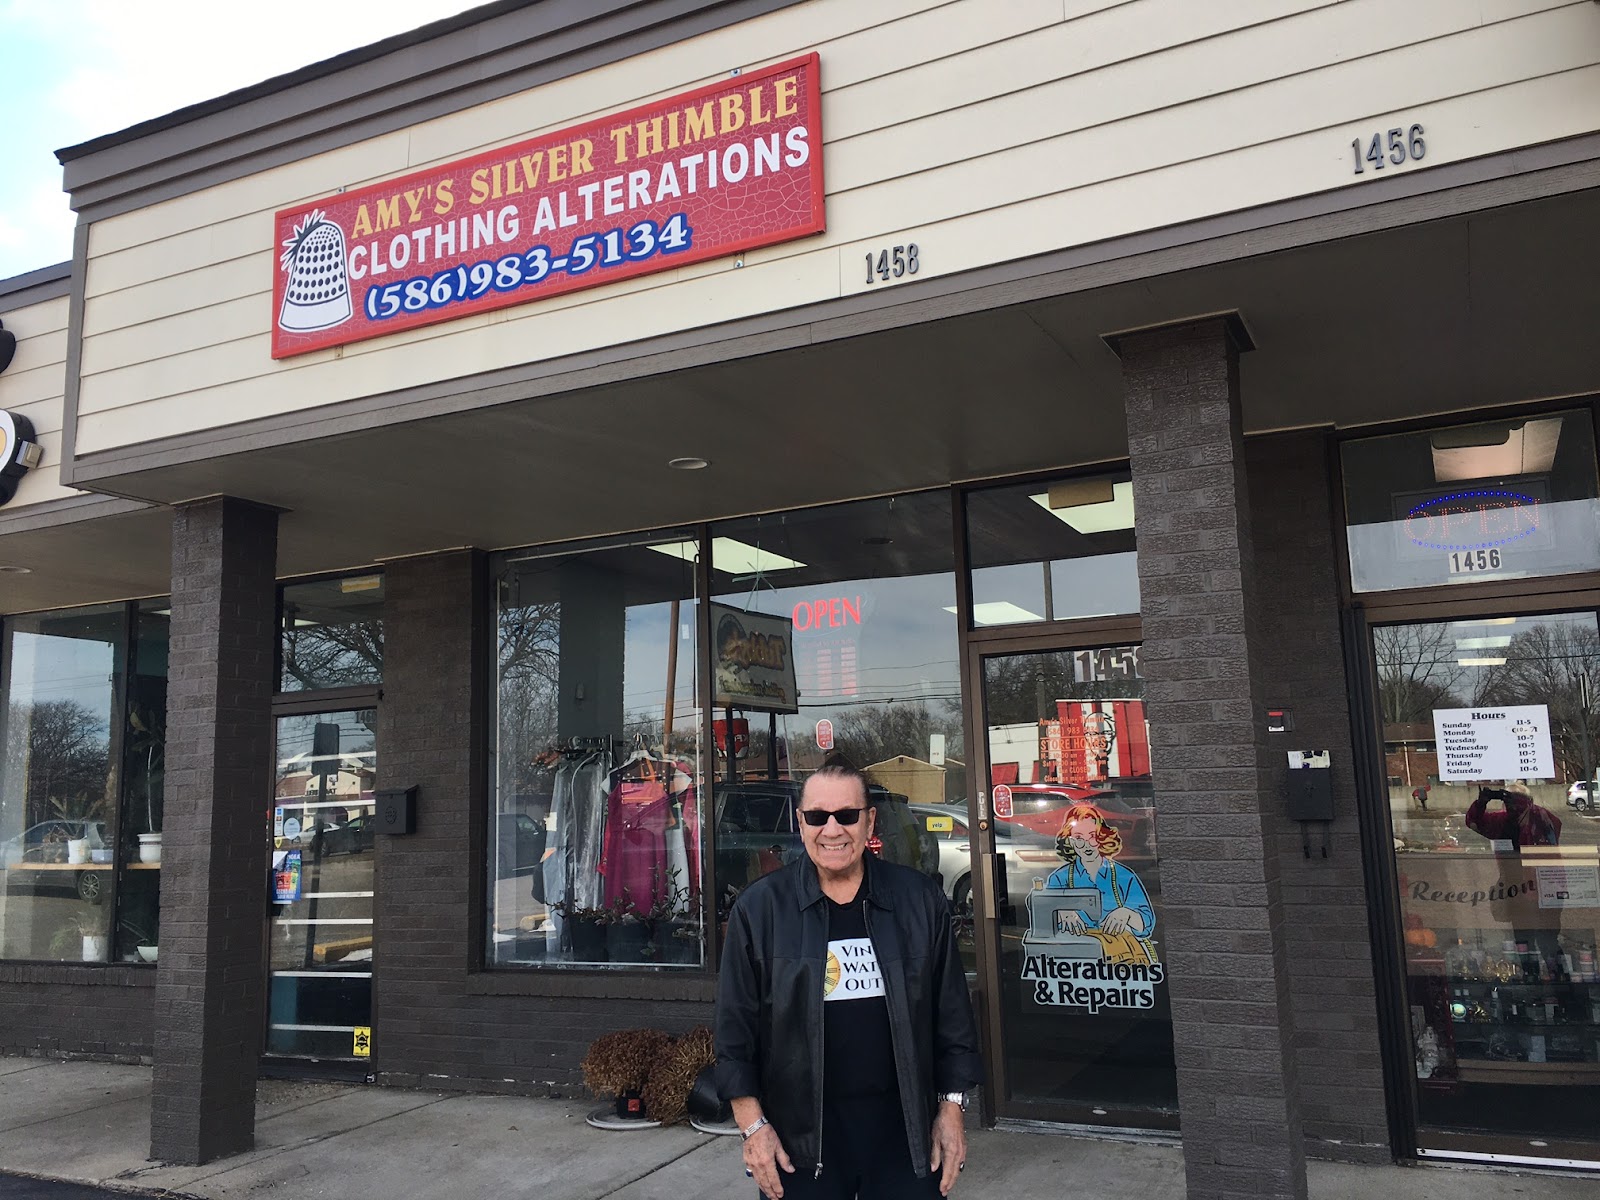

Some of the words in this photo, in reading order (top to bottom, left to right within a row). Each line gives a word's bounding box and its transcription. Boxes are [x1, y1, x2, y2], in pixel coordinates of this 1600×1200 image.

[351, 178, 455, 240] AMY'S
[468, 138, 595, 206] SILVER
[610, 75, 799, 165] THIMBLE
[1351, 123, 1427, 175] 1456
[348, 204, 520, 281] CLOTHING
[532, 126, 810, 236] ALTERATIONS
[366, 214, 690, 320] (586)983-5134
[864, 243, 919, 284] 1458
[1404, 498, 1541, 540] OPEN
[1452, 548, 1500, 573] 1456
[792, 595, 862, 632] OPEN
[1471, 712, 1507, 720] Hours
[1041, 738, 1071, 751] STORE
[1073, 736, 1107, 750] HOURS
[1445, 752, 1483, 760] Thursday
[1446, 760, 1472, 768] Friday
[1447, 767, 1483, 775] Saturday
[1407, 880, 1536, 907] Reception
[841, 945, 872, 957] VIN
[843, 961, 877, 974] WAT
[1022, 953, 1163, 983] Alterations
[845, 977, 883, 991] OUT
[1035, 980, 1054, 1004] &
[1058, 981, 1153, 1013] Repairs
